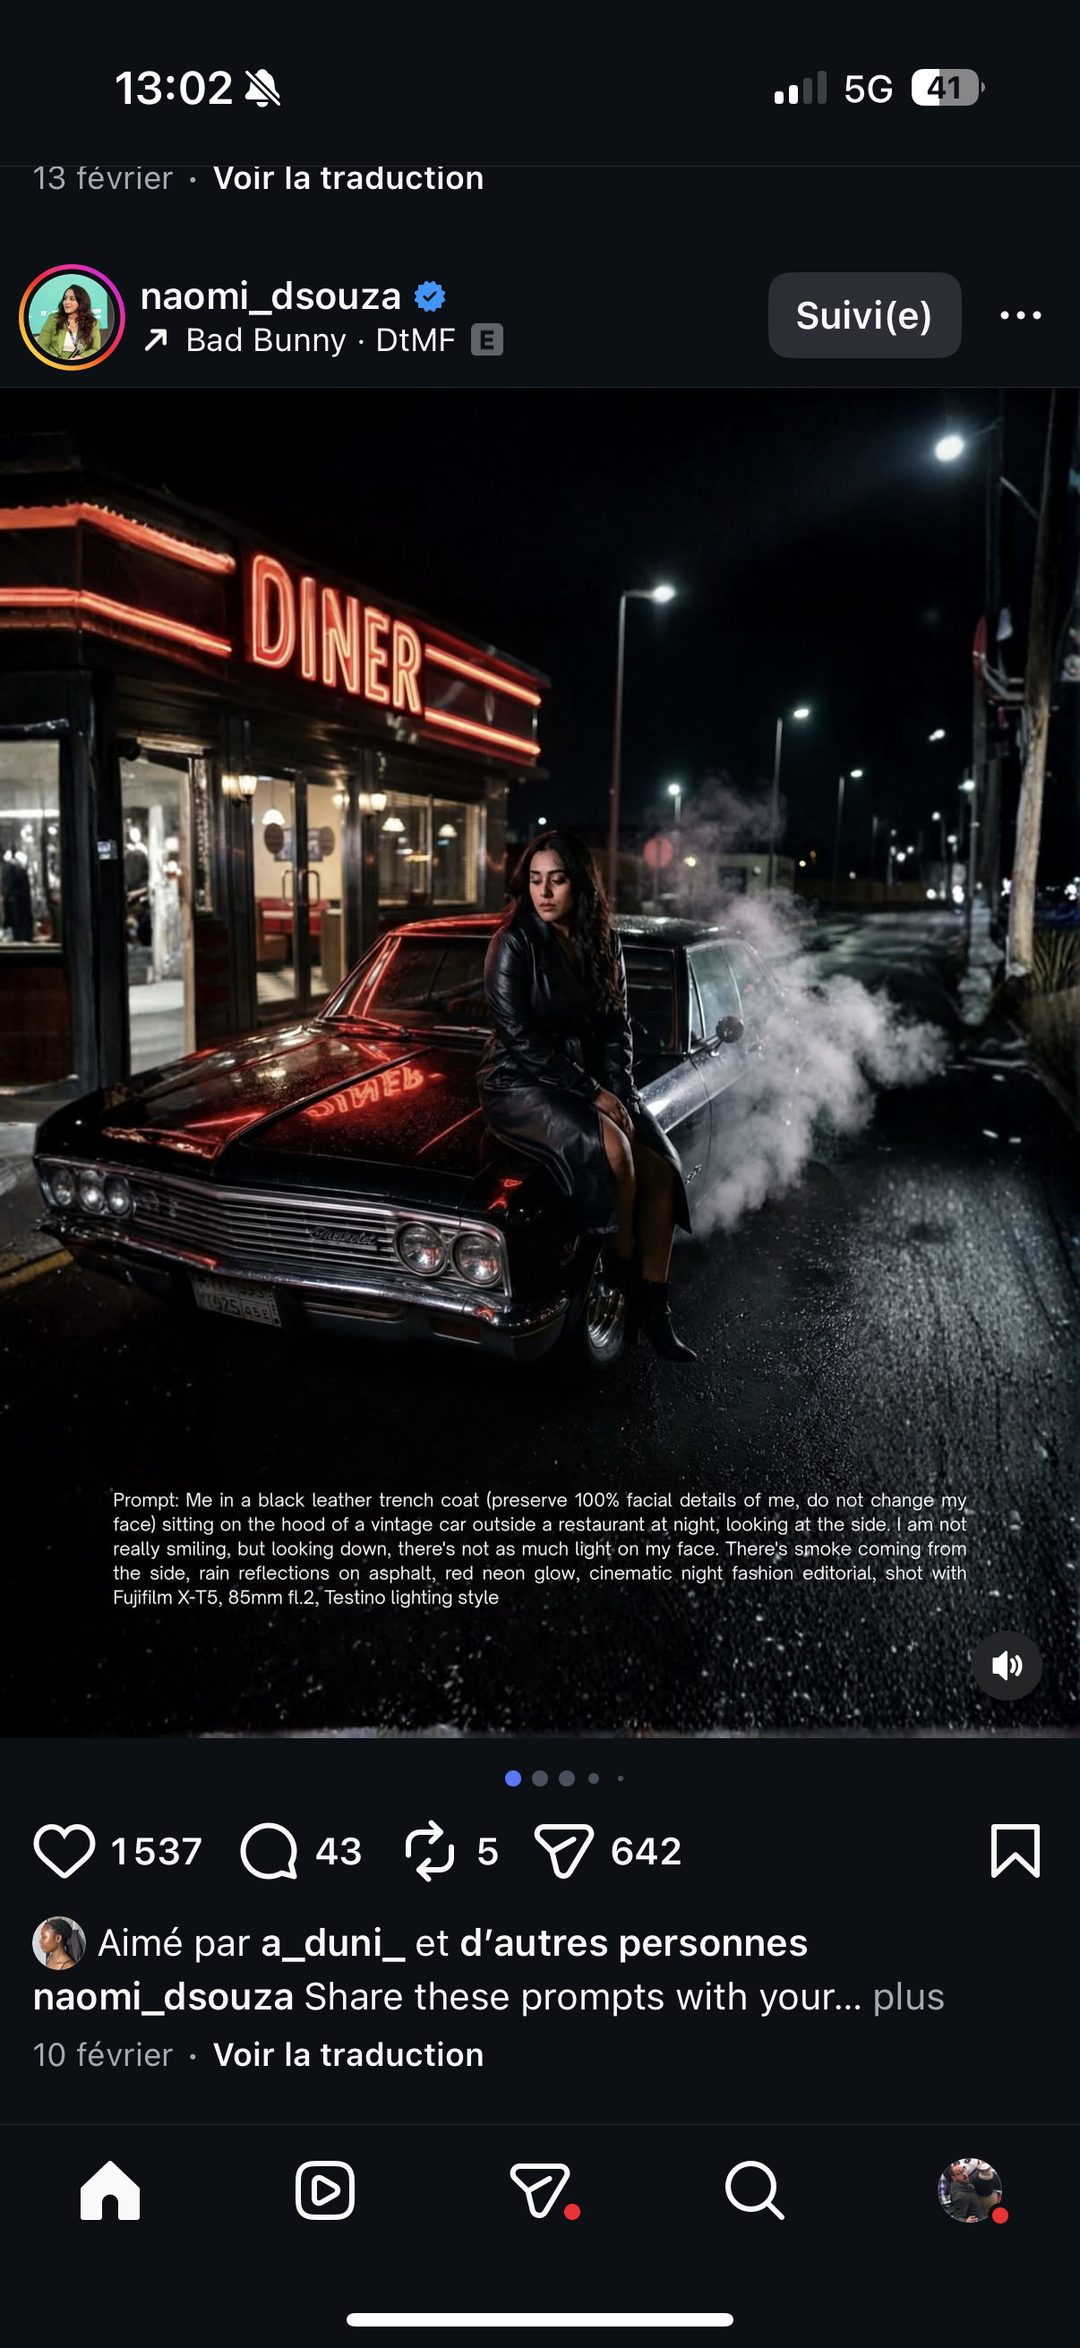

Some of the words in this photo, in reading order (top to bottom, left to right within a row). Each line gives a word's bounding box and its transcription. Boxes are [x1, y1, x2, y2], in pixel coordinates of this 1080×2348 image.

[116, 71, 232, 105] 13:02
[845, 75, 892, 103] 5G
[927, 76, 960, 99] 41
[34, 166, 65, 190] 13
[77, 166, 173, 190] février
[213, 166, 275, 190] Voir
[286, 166, 309, 190] la
[320, 166, 483, 190] traduction
[142, 280, 400, 315] naomi_dsouza
[797, 300, 931, 337] Suivi(e)
[188, 327, 241, 352] Bad
[255, 328, 346, 358] Bunny
[378, 328, 455, 352] DtMF
[252, 555, 422, 714] DINER
[316, 1837, 362, 1866] 43
[478, 1838, 499, 1866] 5
[612, 1837, 682, 1866] 642
[98, 1926, 182, 1957] Aimé
[196, 1935, 250, 1964] par
[262, 1927, 406, 1963] a_duni_
[416, 1931, 448, 1957] et
[620, 1935, 807, 1964] personnes
[34, 1981, 293, 2016] naomi_dsouza
[306, 1981, 402, 2011] Share
[414, 1981, 509, 2011] these
[523, 1983, 664, 2017] prompts
[676, 1981, 746, 2011] with
[875, 1981, 944, 2017] plus
[34, 2042, 65, 2067] 10
[77, 2041, 173, 2067] février
[213, 2041, 275, 2067] Voir
[286, 2041, 309, 2067] la
[320, 2041, 483, 2067] traduction
